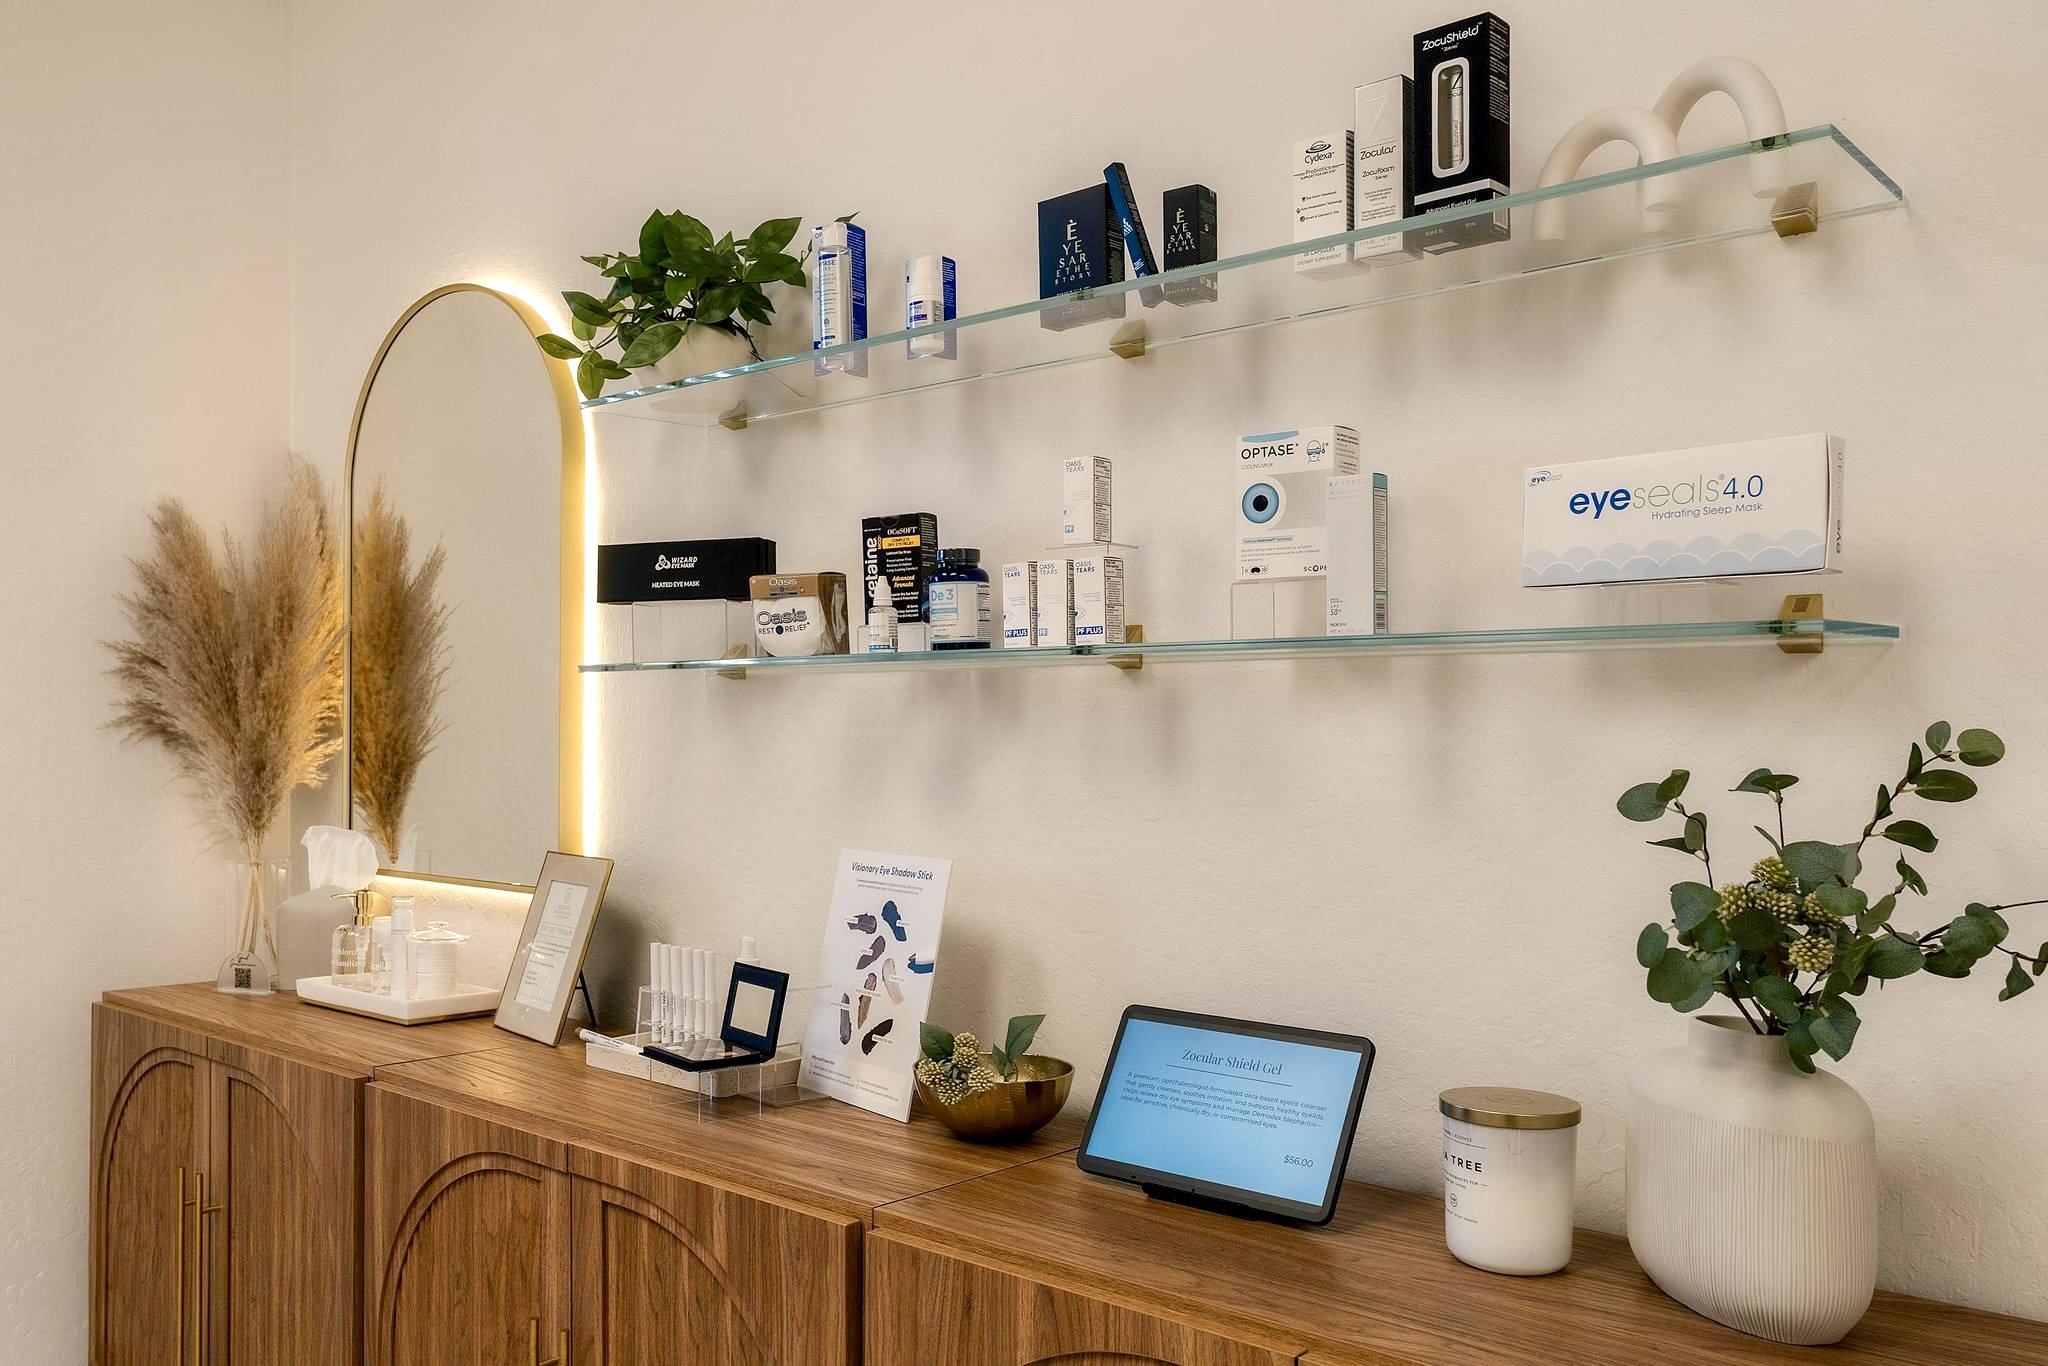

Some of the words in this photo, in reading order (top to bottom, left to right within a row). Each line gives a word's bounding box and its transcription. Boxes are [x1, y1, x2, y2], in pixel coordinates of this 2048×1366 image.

[1422, 25, 1479, 51] ZocuShield
[1304, 152, 1333, 165] Cydexa
[1360, 145, 1396, 160] Zocular
[1305, 166, 1332, 175] Probiotics
[1241, 444, 1294, 460] OPTASE
[1652, 508, 1700, 520] Hydrating
[1703, 506, 1732, 516] Sleep
[1735, 502, 1763, 512] Mask
[1304, 564, 1327, 572] SCOPE
[769, 578, 797, 586] Oasis
[756, 608, 807, 626] Oasis
[785, 624, 808, 632] RELIEF
[1005, 630, 1013, 638] PF
[852, 862, 879, 874] Visionary
[880, 866, 890, 876] Eye
[891, 866, 918, 879] Shadow
[918, 870, 934, 880] Stick
[1182, 1049, 1224, 1065] Zocular
[1225, 1056, 1260, 1072] Shield
[1262, 1062, 1282, 1075] Gel
[1133, 1073, 1160, 1082] premium,
[1244, 1092, 1278, 1103] okra-based
[1280, 1099, 1298, 1107] eyelid
[1300, 1102, 1328, 1112] cleanser
[1138, 1082, 1156, 1090] gently
[1157, 1085, 1181, 1094] cleanses,
[1183, 1090, 1206, 1099] soothes
[1207, 1094, 1233, 1105] irritation,
[1248, 1103, 1275, 1112] supports
[1276, 1107, 1300, 1116] healthy
[1123, 1087, 1138, 1095] Helps
[1140, 1090, 1158, 1098] relieve
[1181, 1098, 1211, 1108] symptoms
[1225, 1107, 1251, 1116] manage
[1252, 1110, 1281, 1121] Demodex
[1143, 1098, 1168, 1108] sensitive,
[1170, 1104, 1200, 1115] chronically
[1201, 1110, 1212, 1118] dry,
[1220, 1114, 1261, 1126] compromised
[1284, 1155, 1314, 1168] $56.00
[1451, 1155, 1482, 1172] TREE
